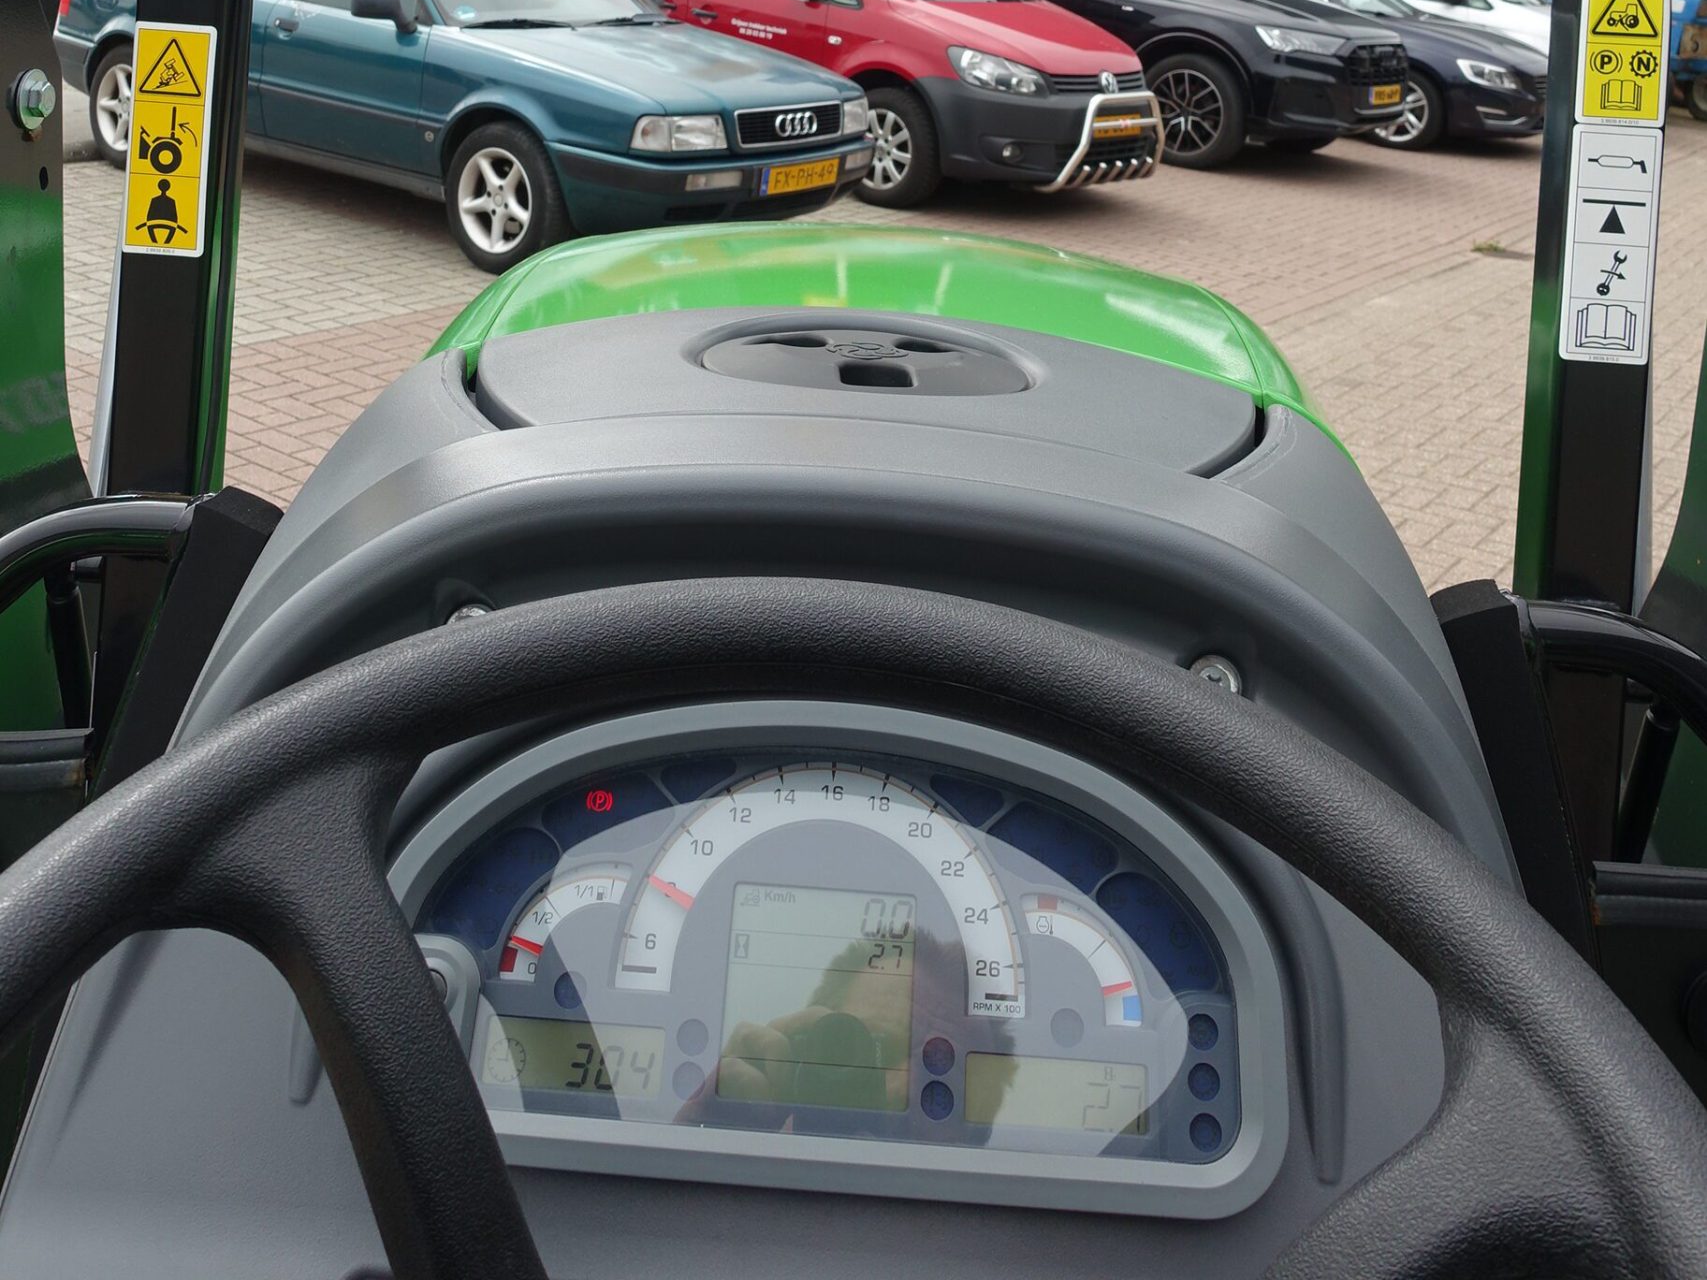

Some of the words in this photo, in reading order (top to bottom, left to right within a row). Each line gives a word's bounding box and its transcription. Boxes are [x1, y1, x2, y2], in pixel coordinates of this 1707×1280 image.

[773, 788, 797, 805] 14
[820, 784, 845, 802] 16
[867, 795, 891, 813] 18
[728, 807, 753, 824] 12
[907, 822, 933, 839] 20
[690, 839, 714, 857] 10
[940, 860, 965, 878] 22
[763, 889, 797, 905] Km/h
[964, 907, 989, 926] 24
[644, 932, 658, 951] 6
[975, 959, 1001, 978] 26
[973, 1001, 993, 1013] RPM
[1003, 1004, 1021, 1014] 100
